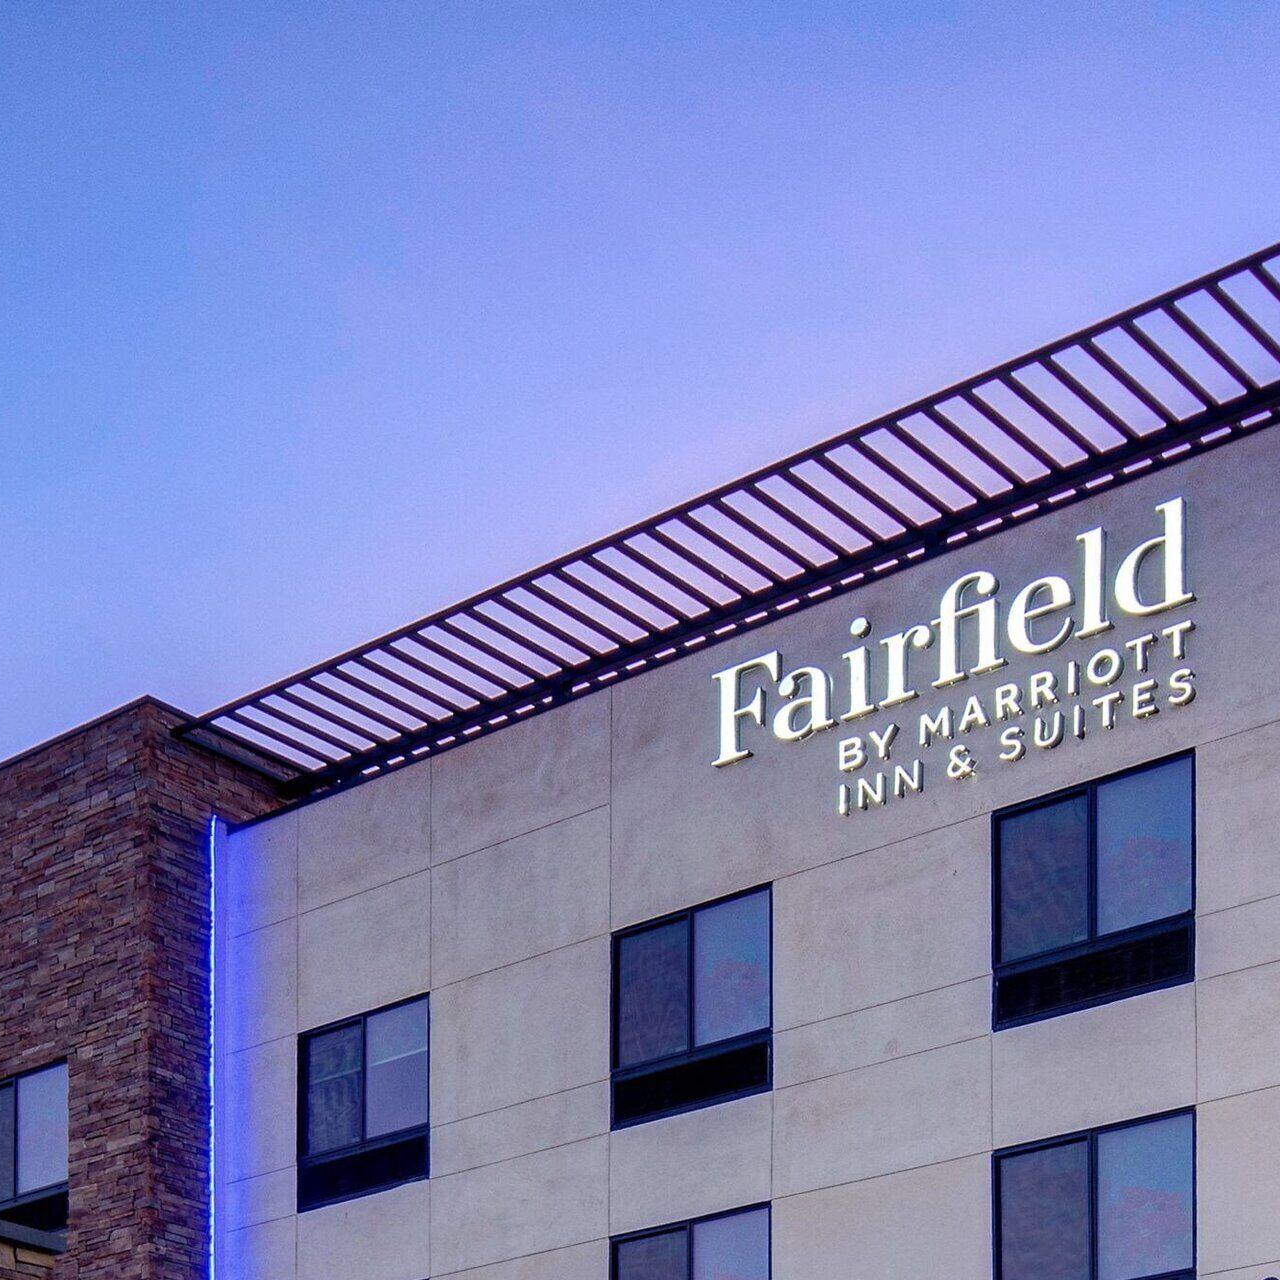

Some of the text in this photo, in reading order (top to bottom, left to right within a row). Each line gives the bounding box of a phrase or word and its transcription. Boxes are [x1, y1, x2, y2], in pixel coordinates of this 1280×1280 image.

[711, 496, 1195, 767] Fairfield
[838, 619, 1195, 771] BY MARRIOTT
[838, 668, 1197, 815] INN & SUITES
